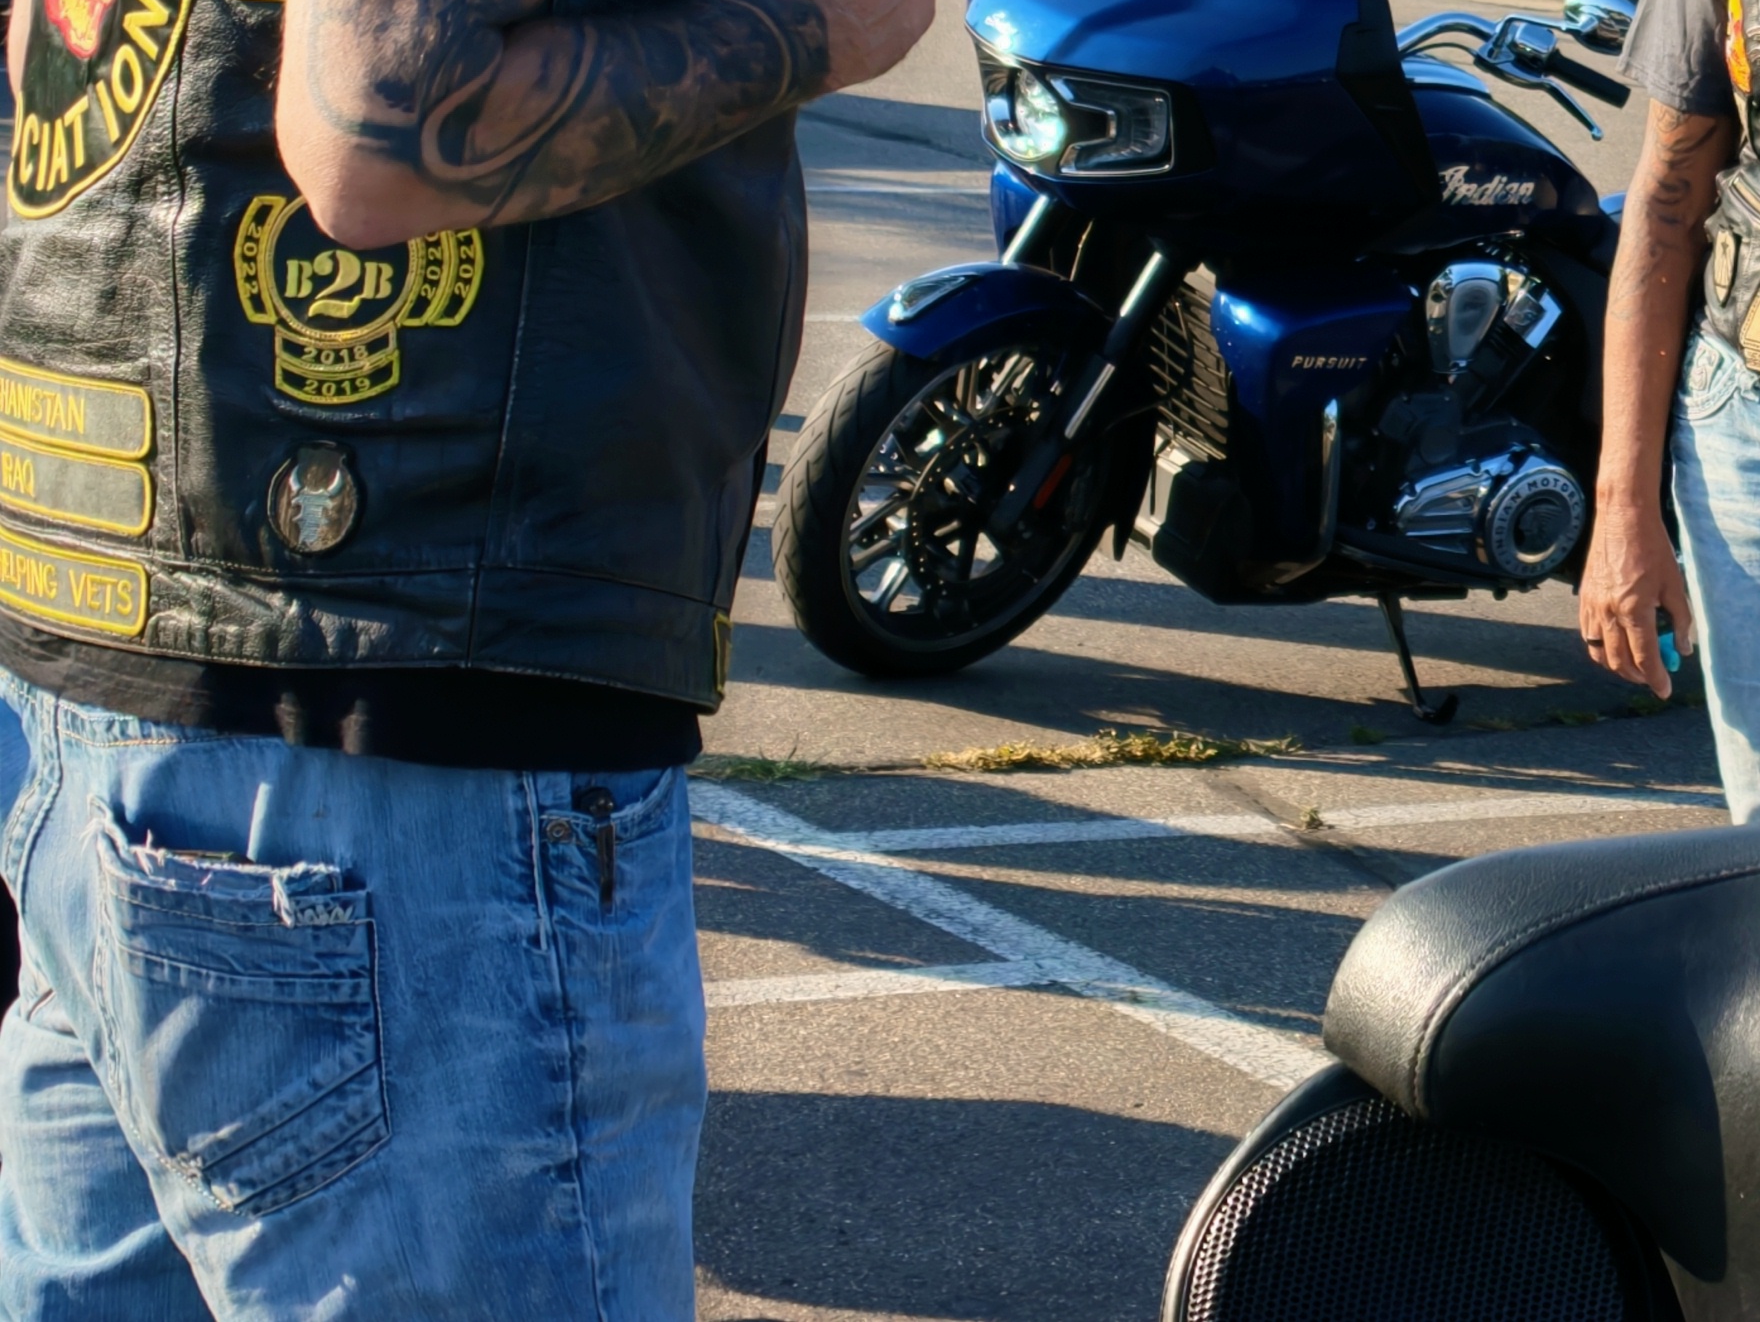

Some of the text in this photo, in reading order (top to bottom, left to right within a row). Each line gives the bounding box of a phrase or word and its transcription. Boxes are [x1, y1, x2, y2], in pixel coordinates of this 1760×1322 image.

[1438, 165, 1535, 206] Indian
[242, 223, 262, 294] 2022
[455, 231, 476, 297] 2021
[285, 250, 394, 318] B2B
[301, 345, 369, 364] 2018
[1291, 355, 1368, 370] PURSUIT
[303, 378, 371, 396] 2019
[69, 569, 132, 615] VETS
